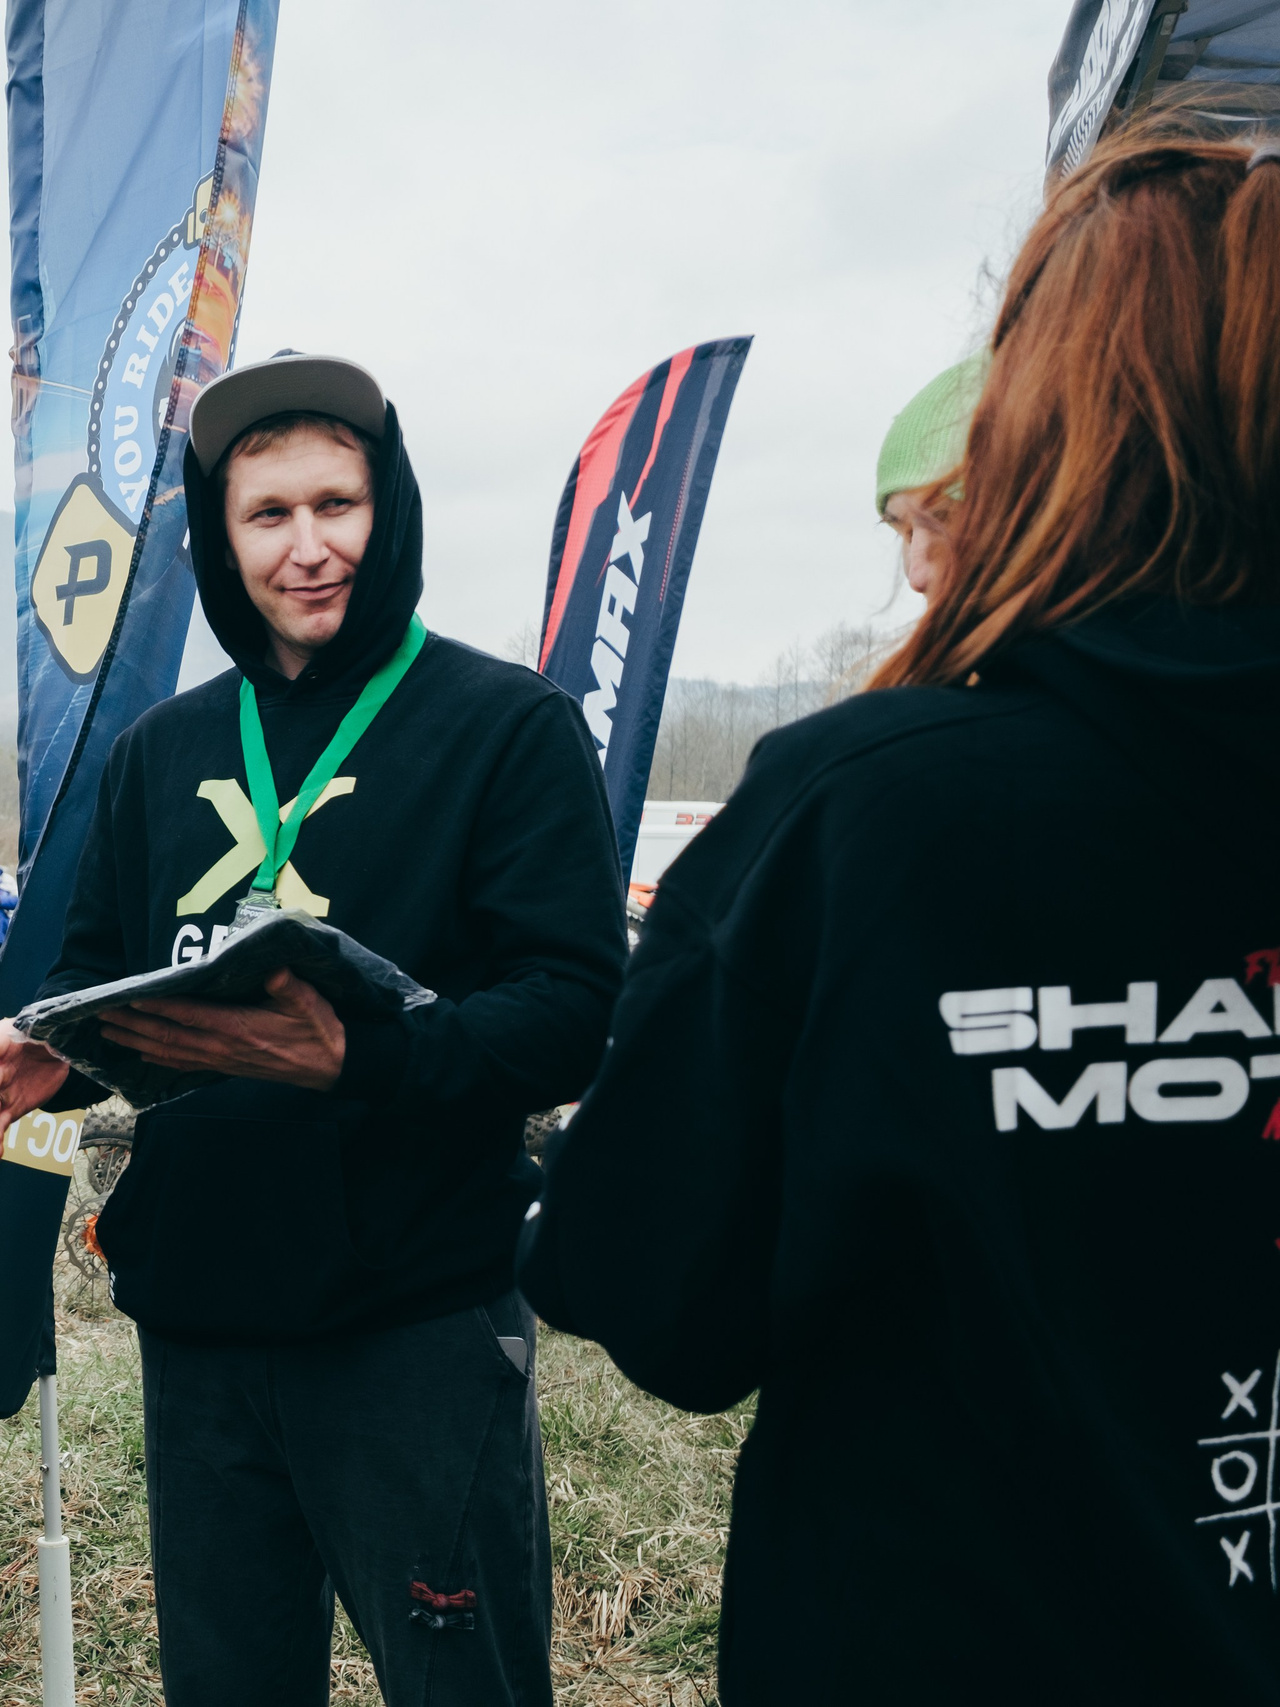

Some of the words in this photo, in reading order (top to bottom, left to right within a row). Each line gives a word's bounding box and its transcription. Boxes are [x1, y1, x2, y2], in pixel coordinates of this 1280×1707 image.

[121, 260, 196, 390] RIDE
[116, 405, 150, 513] YOU
[583, 490, 652, 771] MAX
[939, 978, 1280, 1055] SHA
